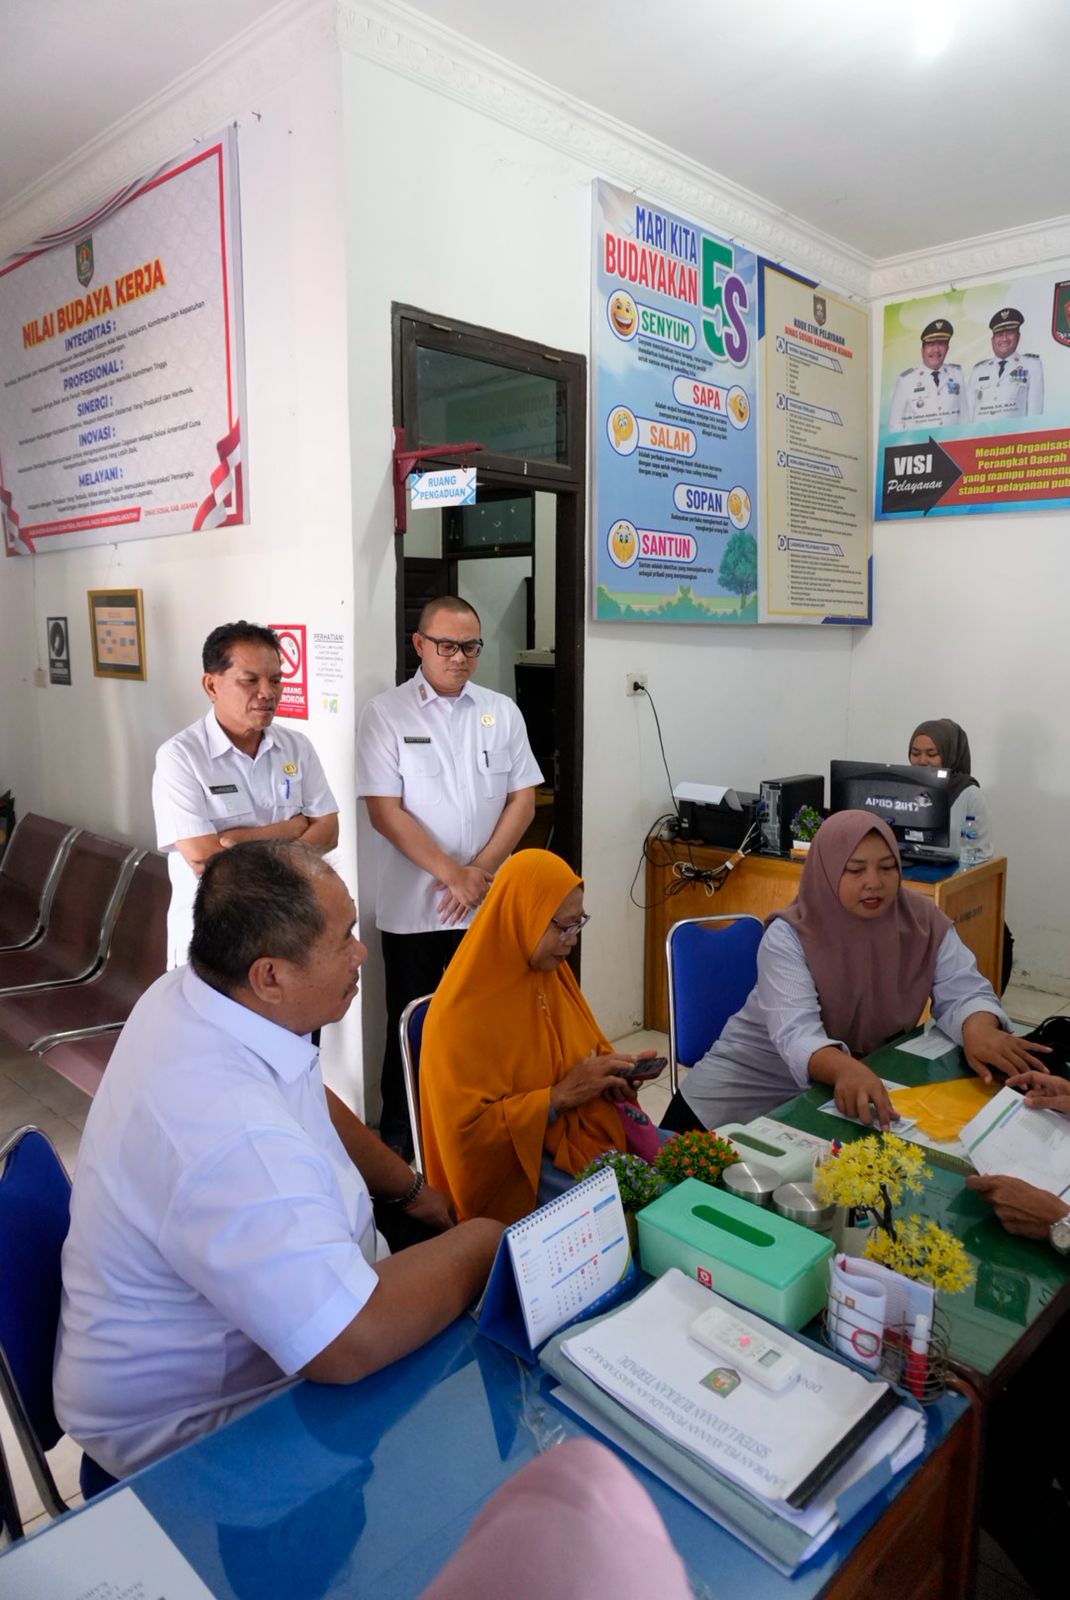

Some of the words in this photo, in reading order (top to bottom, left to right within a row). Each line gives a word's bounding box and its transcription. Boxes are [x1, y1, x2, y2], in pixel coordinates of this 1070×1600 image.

[636, 205, 667, 251] MARI
[671, 221, 697, 264] KITA
[22, 313, 54, 349] NILAI
[56, 285, 113, 334] BUDAYA
[115, 259, 166, 307] KERJA
[605, 233, 698, 305] BUDAYAKAN
[702, 236, 748, 363] 5S
[64, 321, 112, 351] INTEGRITAS
[641, 310, 690, 346] SENYUM
[77, 395, 108, 417] SINERGI
[692, 384, 721, 410] SAPA
[79, 426, 111, 447] INOVASI
[650, 425, 691, 454] SALAM
[975, 444, 1014, 459] Menjadi
[978, 456, 1028, 470] Perangkat
[1030, 452, 1067, 465] Daerah
[894, 454, 933, 476] VISI
[79, 467, 118, 488] MELAYANI
[428, 475, 456, 487] RUANG
[887, 479, 943, 495] Pelayanan
[959, 483, 995, 496] standar
[997, 480, 1049, 494] pelayanan
[962, 473, 986, 485] yang
[988, 470, 1024, 483] mampu
[420, 487, 466, 500] PENGADUAN
[686, 489, 723, 513] SOPAN
[642, 534, 691, 559] SANTUN
[280, 694, 305, 704] ROKOK
